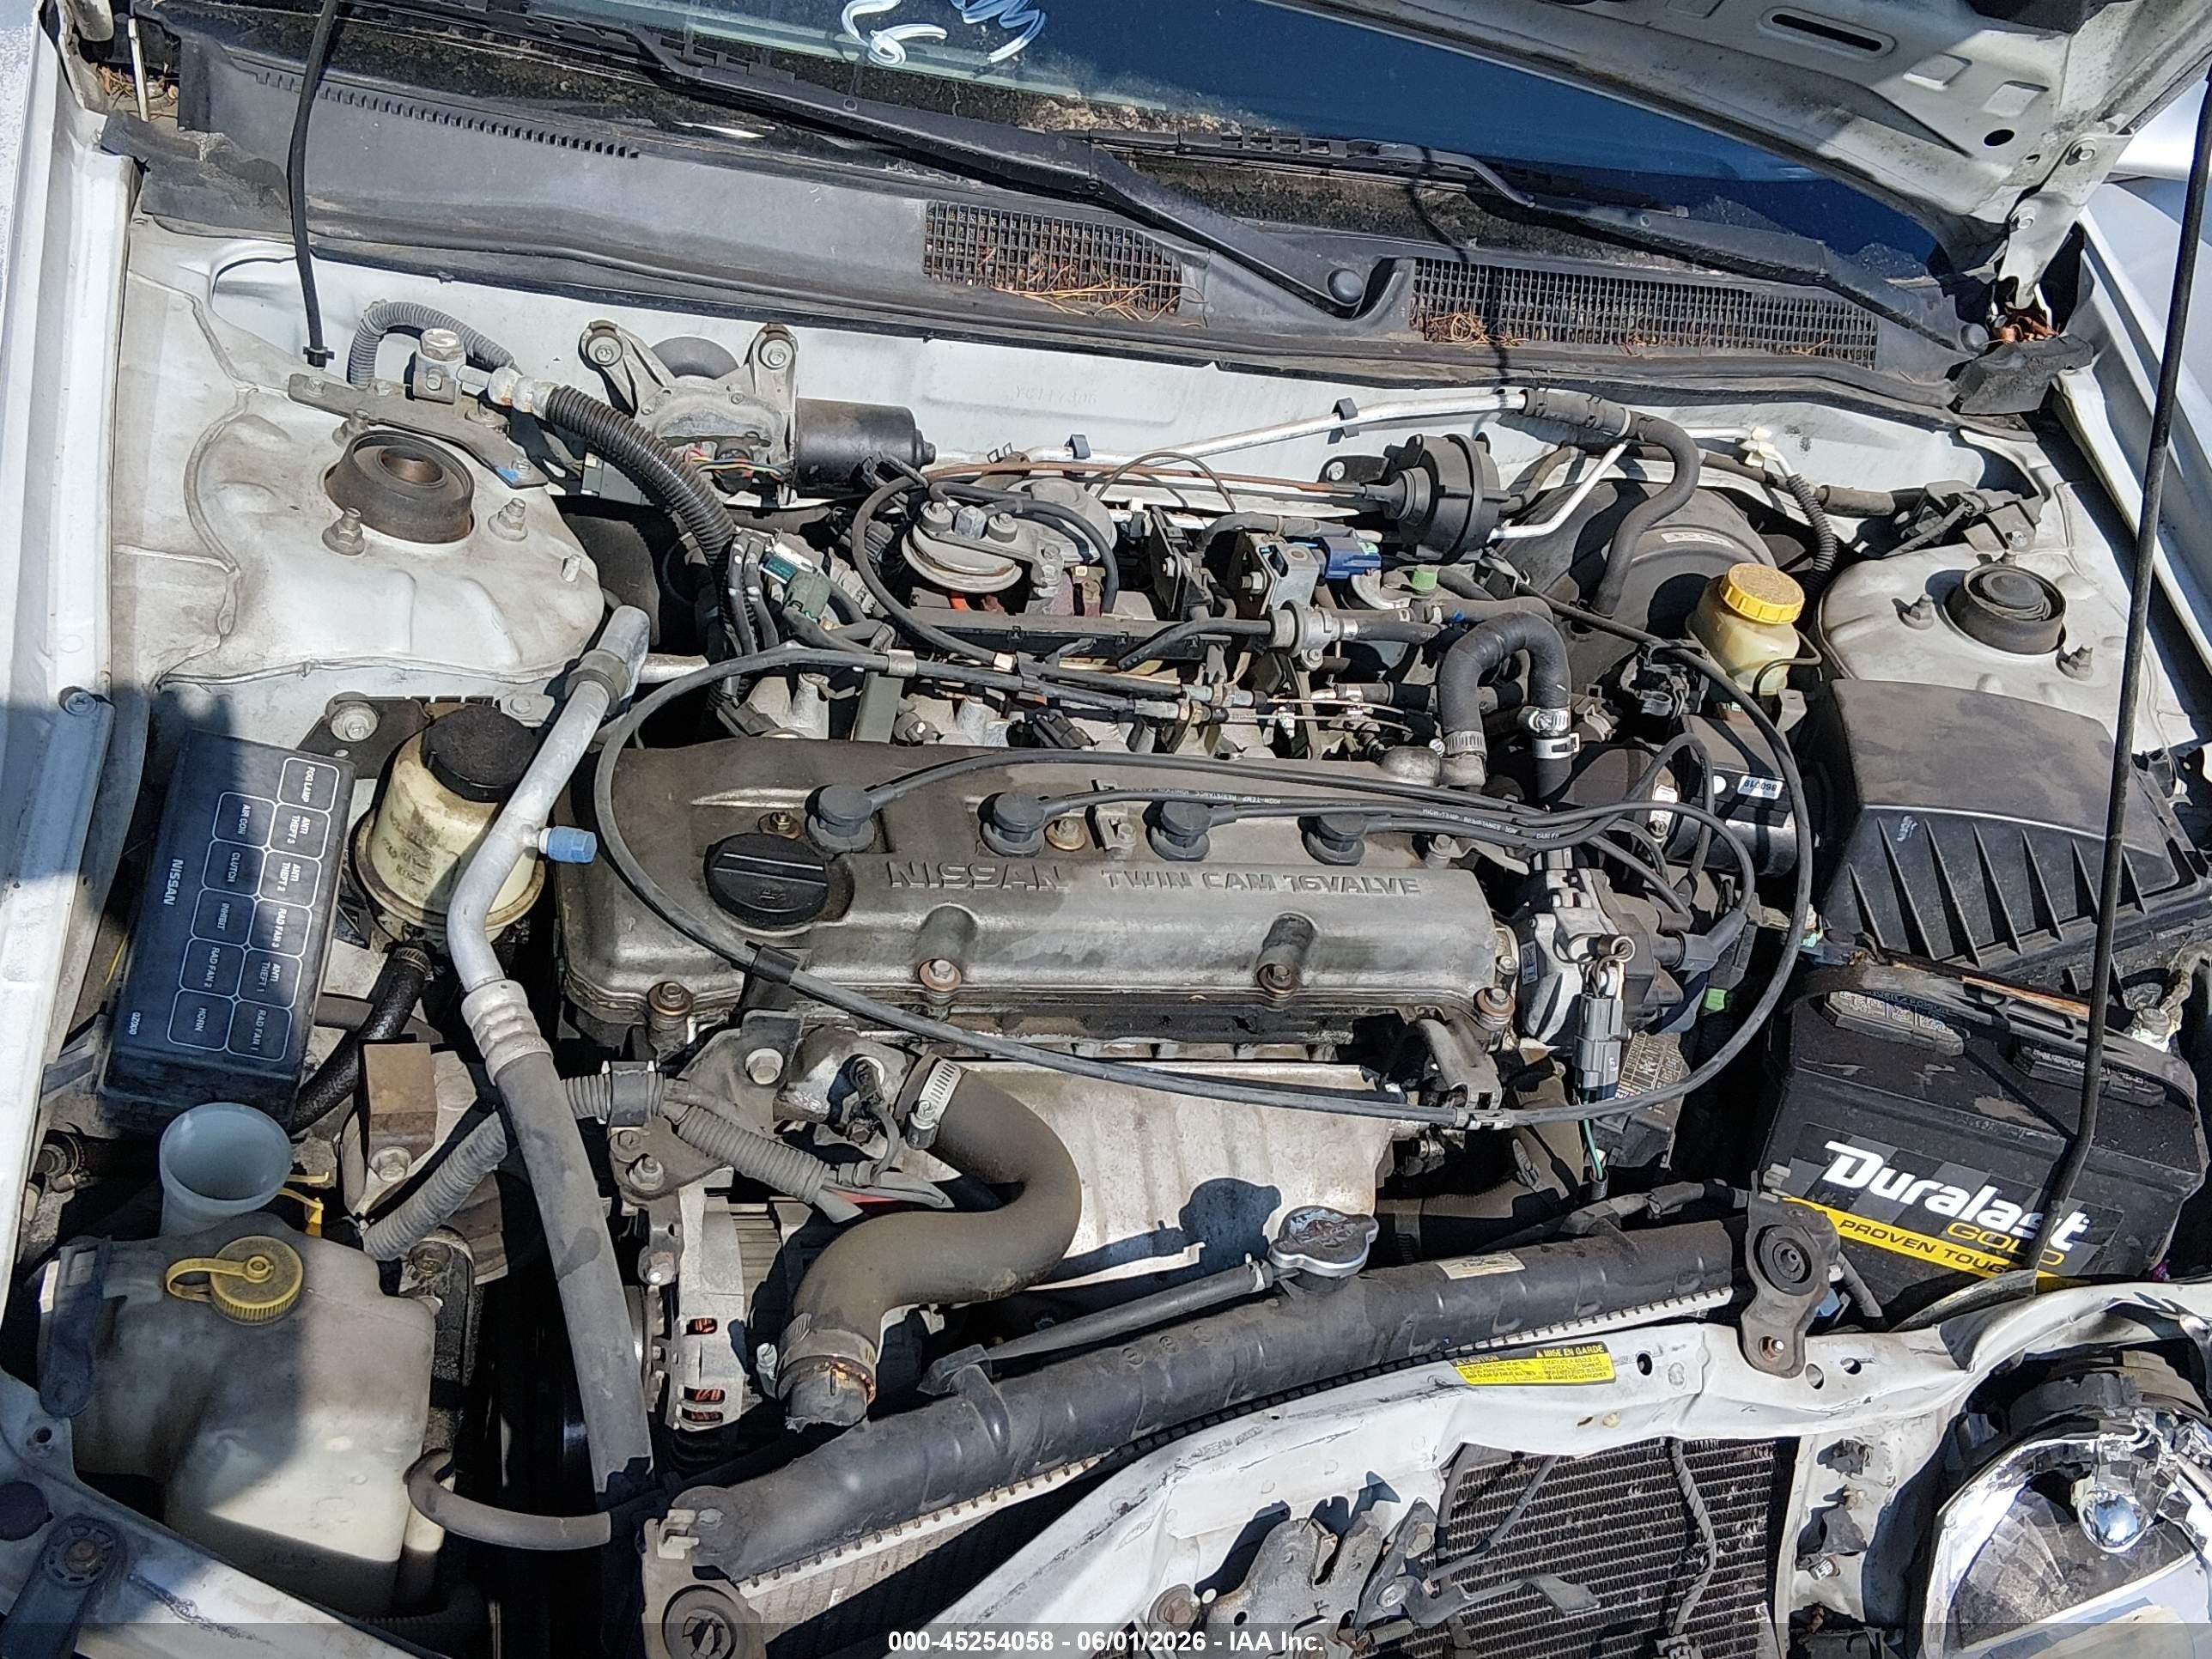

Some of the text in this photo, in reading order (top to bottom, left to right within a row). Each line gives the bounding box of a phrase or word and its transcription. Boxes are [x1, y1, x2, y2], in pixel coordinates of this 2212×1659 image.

[1744, 780, 1777, 792] 860019
[237, 818, 247, 835] CON
[288, 815, 301, 837] THEFT
[300, 817, 311, 835] ANTI
[227, 852, 240, 883] CLUTCH
[278, 861, 291, 884] THEFT
[290, 863, 301, 882] ANTI
[885, 860, 1070, 891] NISSAN
[163, 858, 184, 906] NISSAN
[1101, 869, 1194, 890] TWIN
[1201, 871, 1279, 892] CAM
[276, 908, 288, 925] RAD
[273, 925, 284, 940] FAN
[209, 947, 221, 964] RAD
[205, 967, 216, 983] FAN
[259, 961, 270, 987] THEFT
[270, 963, 281, 982] ANTI
[194, 1007, 207, 1031] HORN
[255, 1009, 267, 1028] RAD
[252, 1028, 264, 1046] FAN
[1821, 1140, 2089, 1251] Duralast
[1838, 1219, 1936, 1254] PROVEN
[1563, 1347, 1573, 1356] EN
[1575, 1345, 1604, 1355] GARDE
